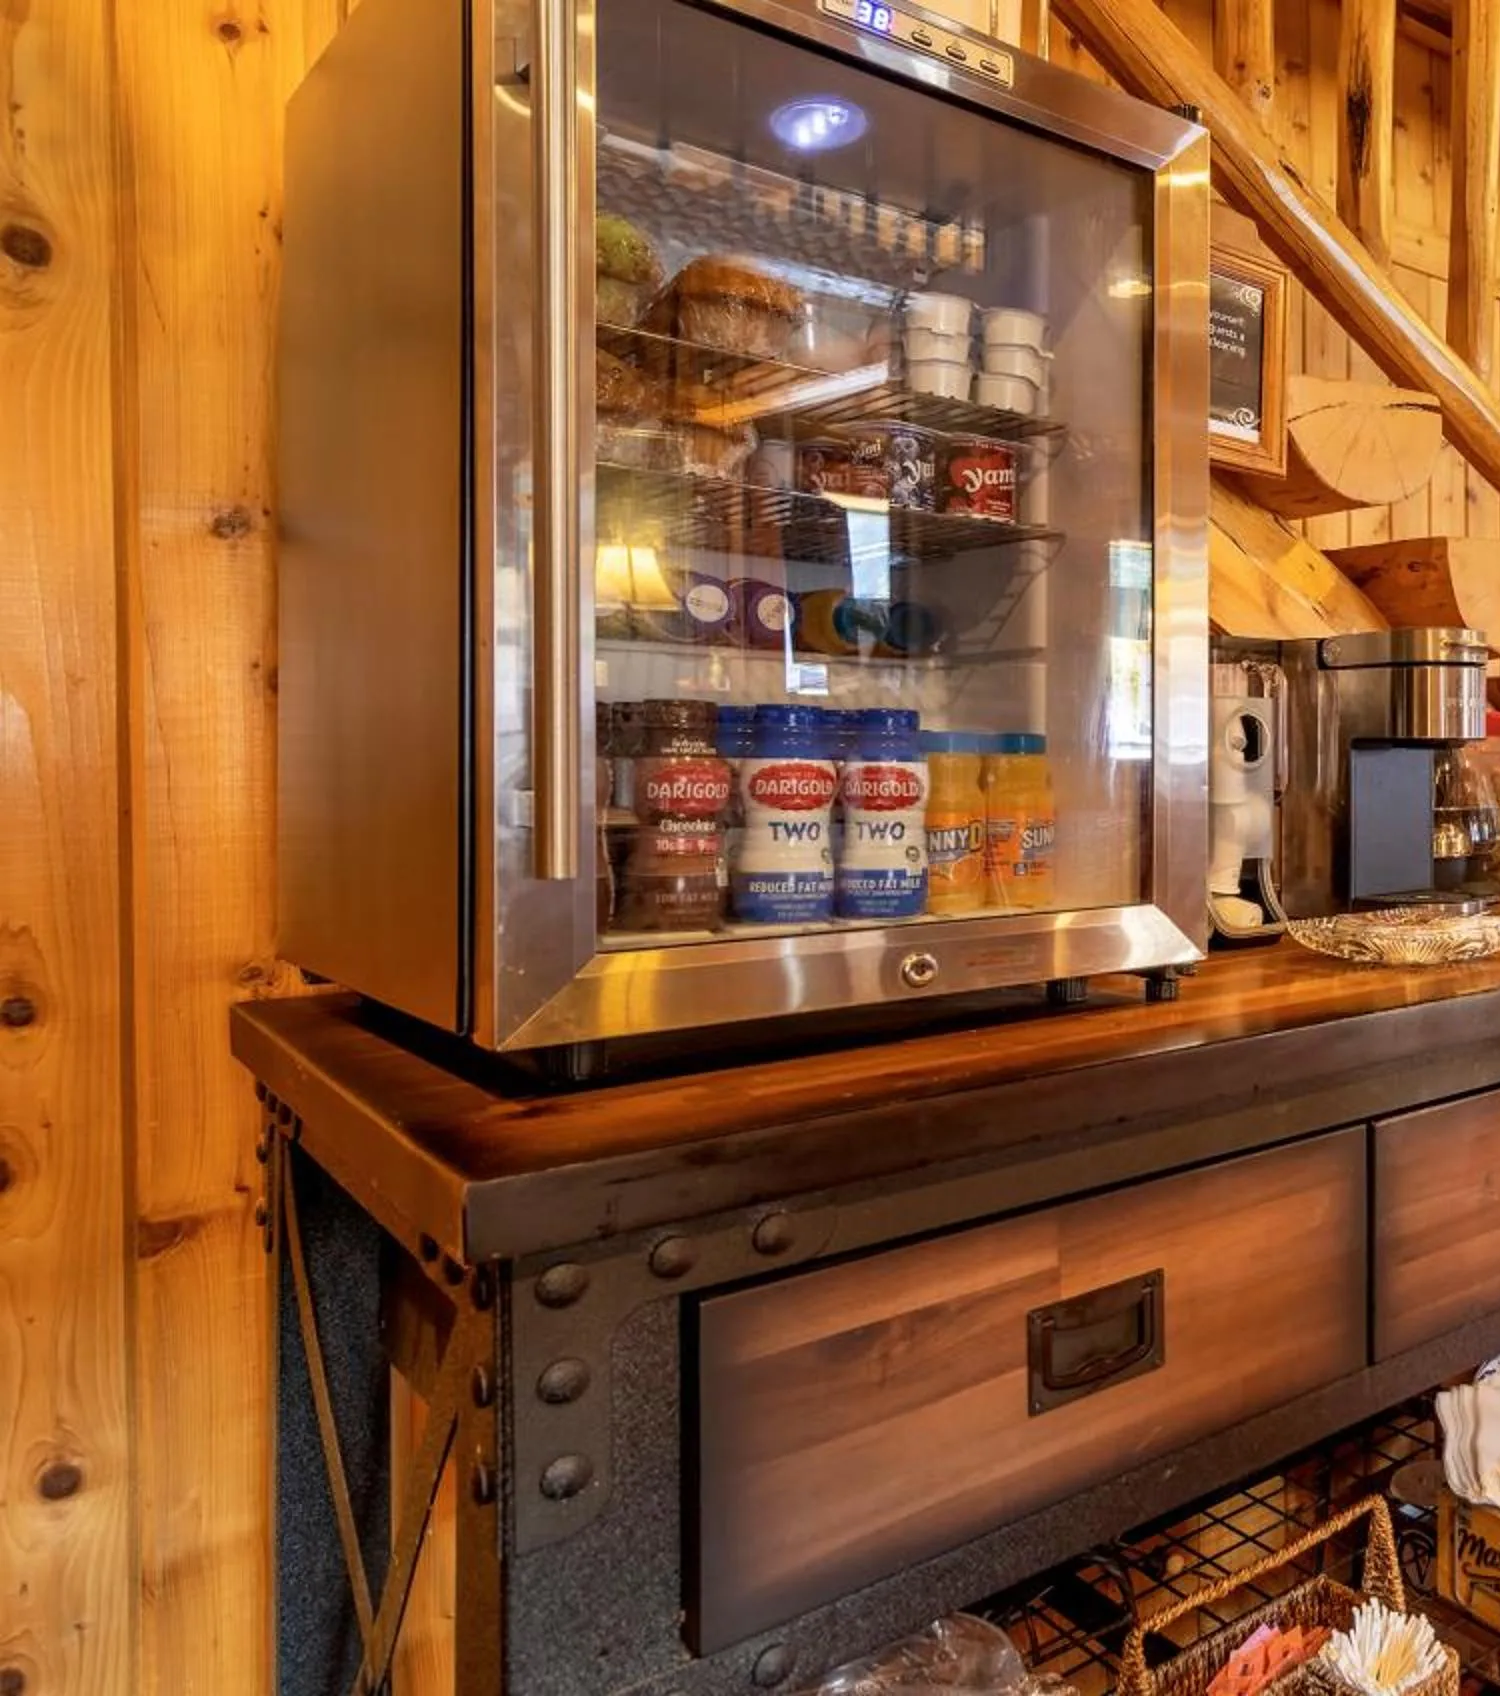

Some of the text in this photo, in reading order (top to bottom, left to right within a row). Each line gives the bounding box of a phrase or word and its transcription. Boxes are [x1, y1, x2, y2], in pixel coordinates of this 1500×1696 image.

[857, 1, 889, 32] 38
[647, 782, 729, 799] DARIGOLD
[768, 821, 821, 841] TWO
[857, 821, 905, 841] TWO
[749, 879, 795, 894] REDUCED
[798, 881, 817, 893] FAT
